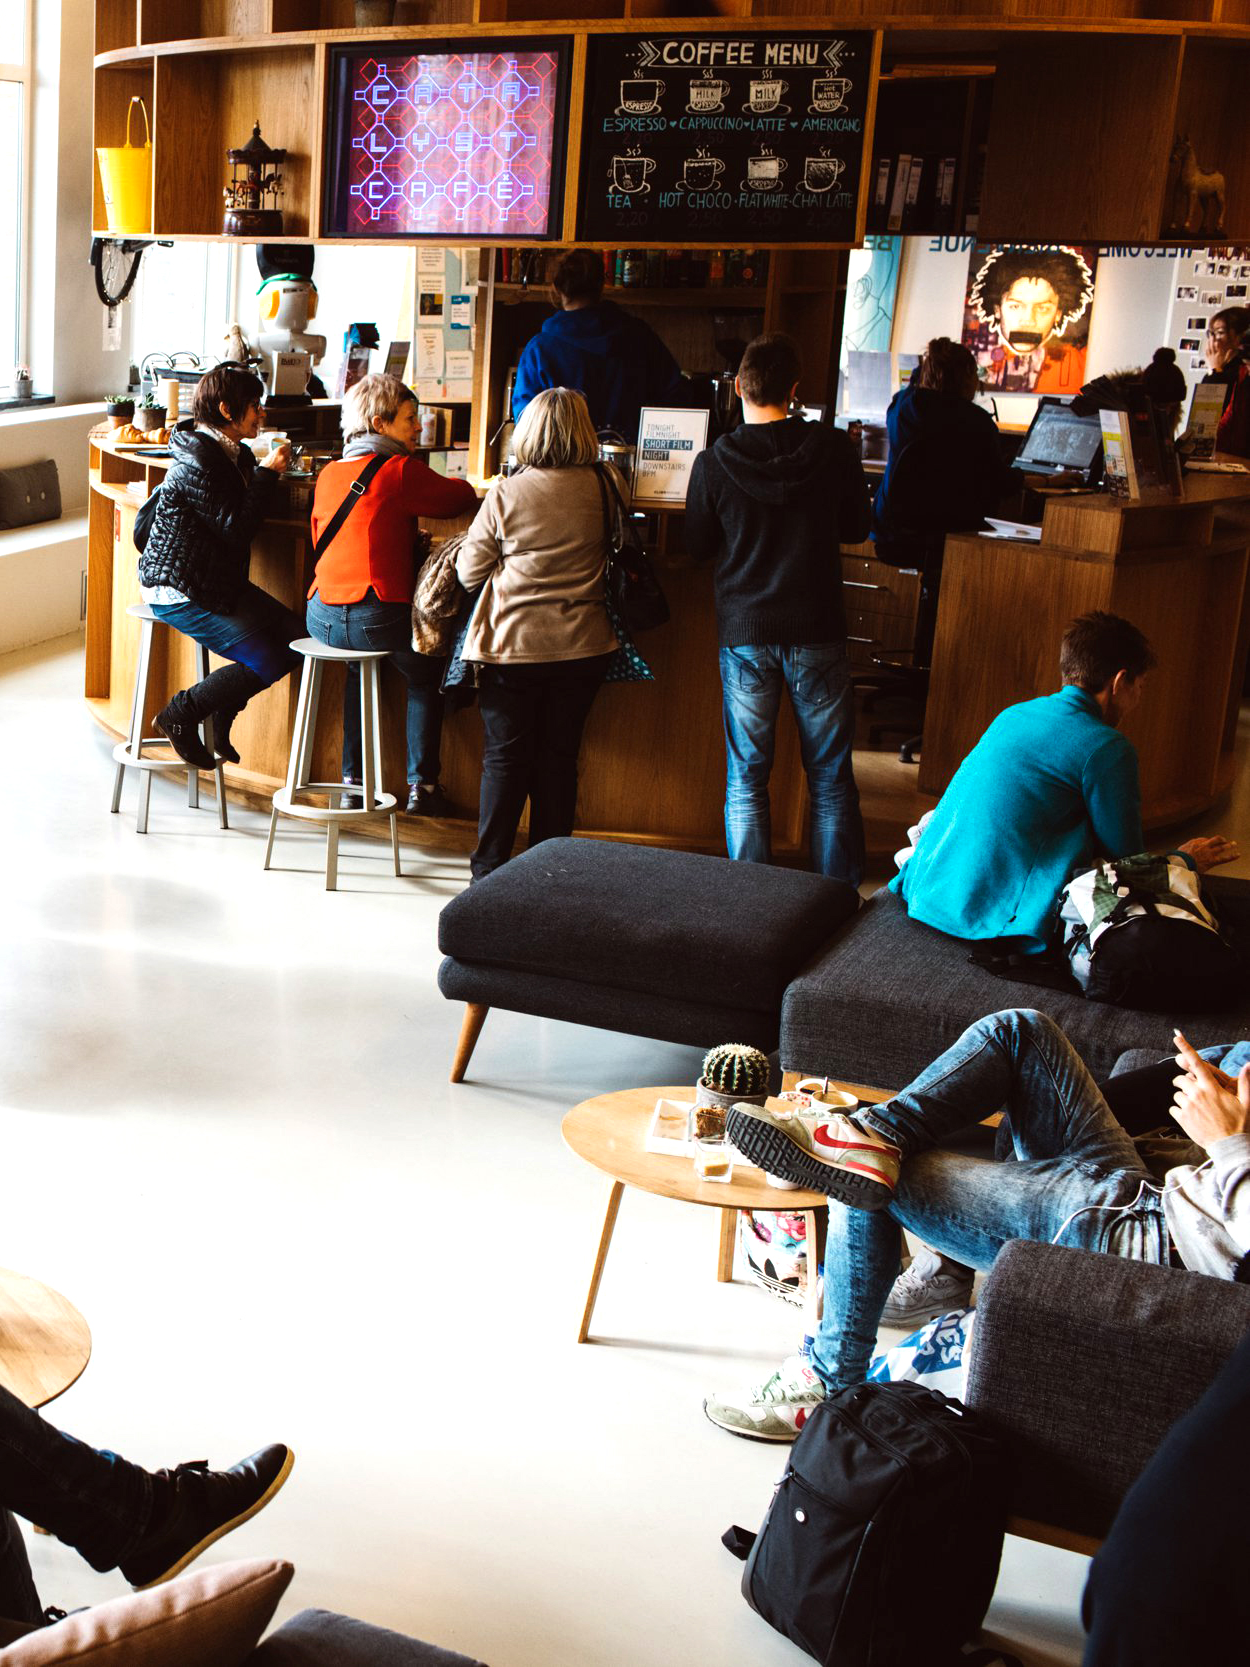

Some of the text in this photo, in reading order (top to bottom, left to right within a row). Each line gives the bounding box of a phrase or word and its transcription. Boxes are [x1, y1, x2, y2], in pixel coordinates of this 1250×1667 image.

[662, 41, 819, 65] COFFEE MENU
[372, 82, 520, 105] CATA
[696, 90, 715, 99] MILK
[755, 88, 778, 100] MILK
[817, 92, 841, 100] WATER
[603, 116, 861, 133] ESPRESSO CAPPUCCINO LATTE AMERICANO
[370, 131, 517, 152] LYST
[606, 194, 632, 209] TEA
[658, 192, 685, 208] HOT
[687, 192, 732, 209] CHOCO
[792, 193, 822, 208] CHAI
[826, 193, 854, 208] LATTE
[647, 423, 675, 432] TONIGHT
[645, 431, 680, 439] FILMNIGHT
[645, 440, 691, 450] SHORT FILM
[644, 451, 668, 460] NIGHT
[643, 461, 686, 471] DOWNSTAIRS
